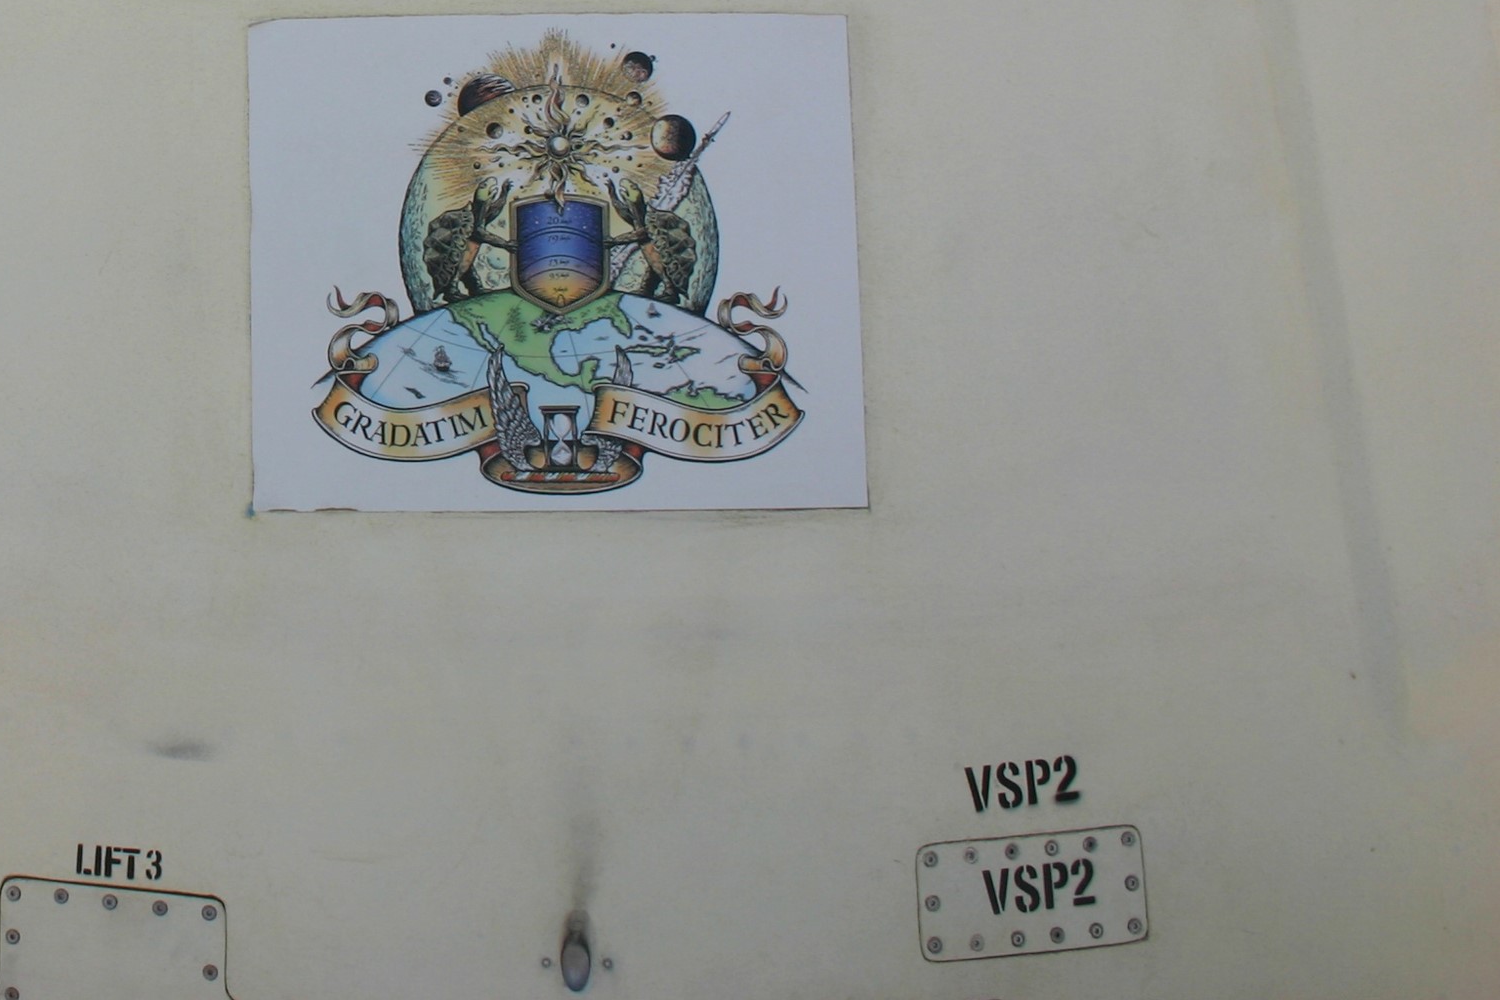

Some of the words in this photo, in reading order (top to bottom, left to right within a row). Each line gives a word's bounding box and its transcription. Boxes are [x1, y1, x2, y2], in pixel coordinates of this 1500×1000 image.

[333, 401, 488, 447] GRADATIM
[606, 398, 789, 449] FEROCITER
[964, 755, 1081, 813] VSP2
[982, 858, 1096, 915] VSP2
